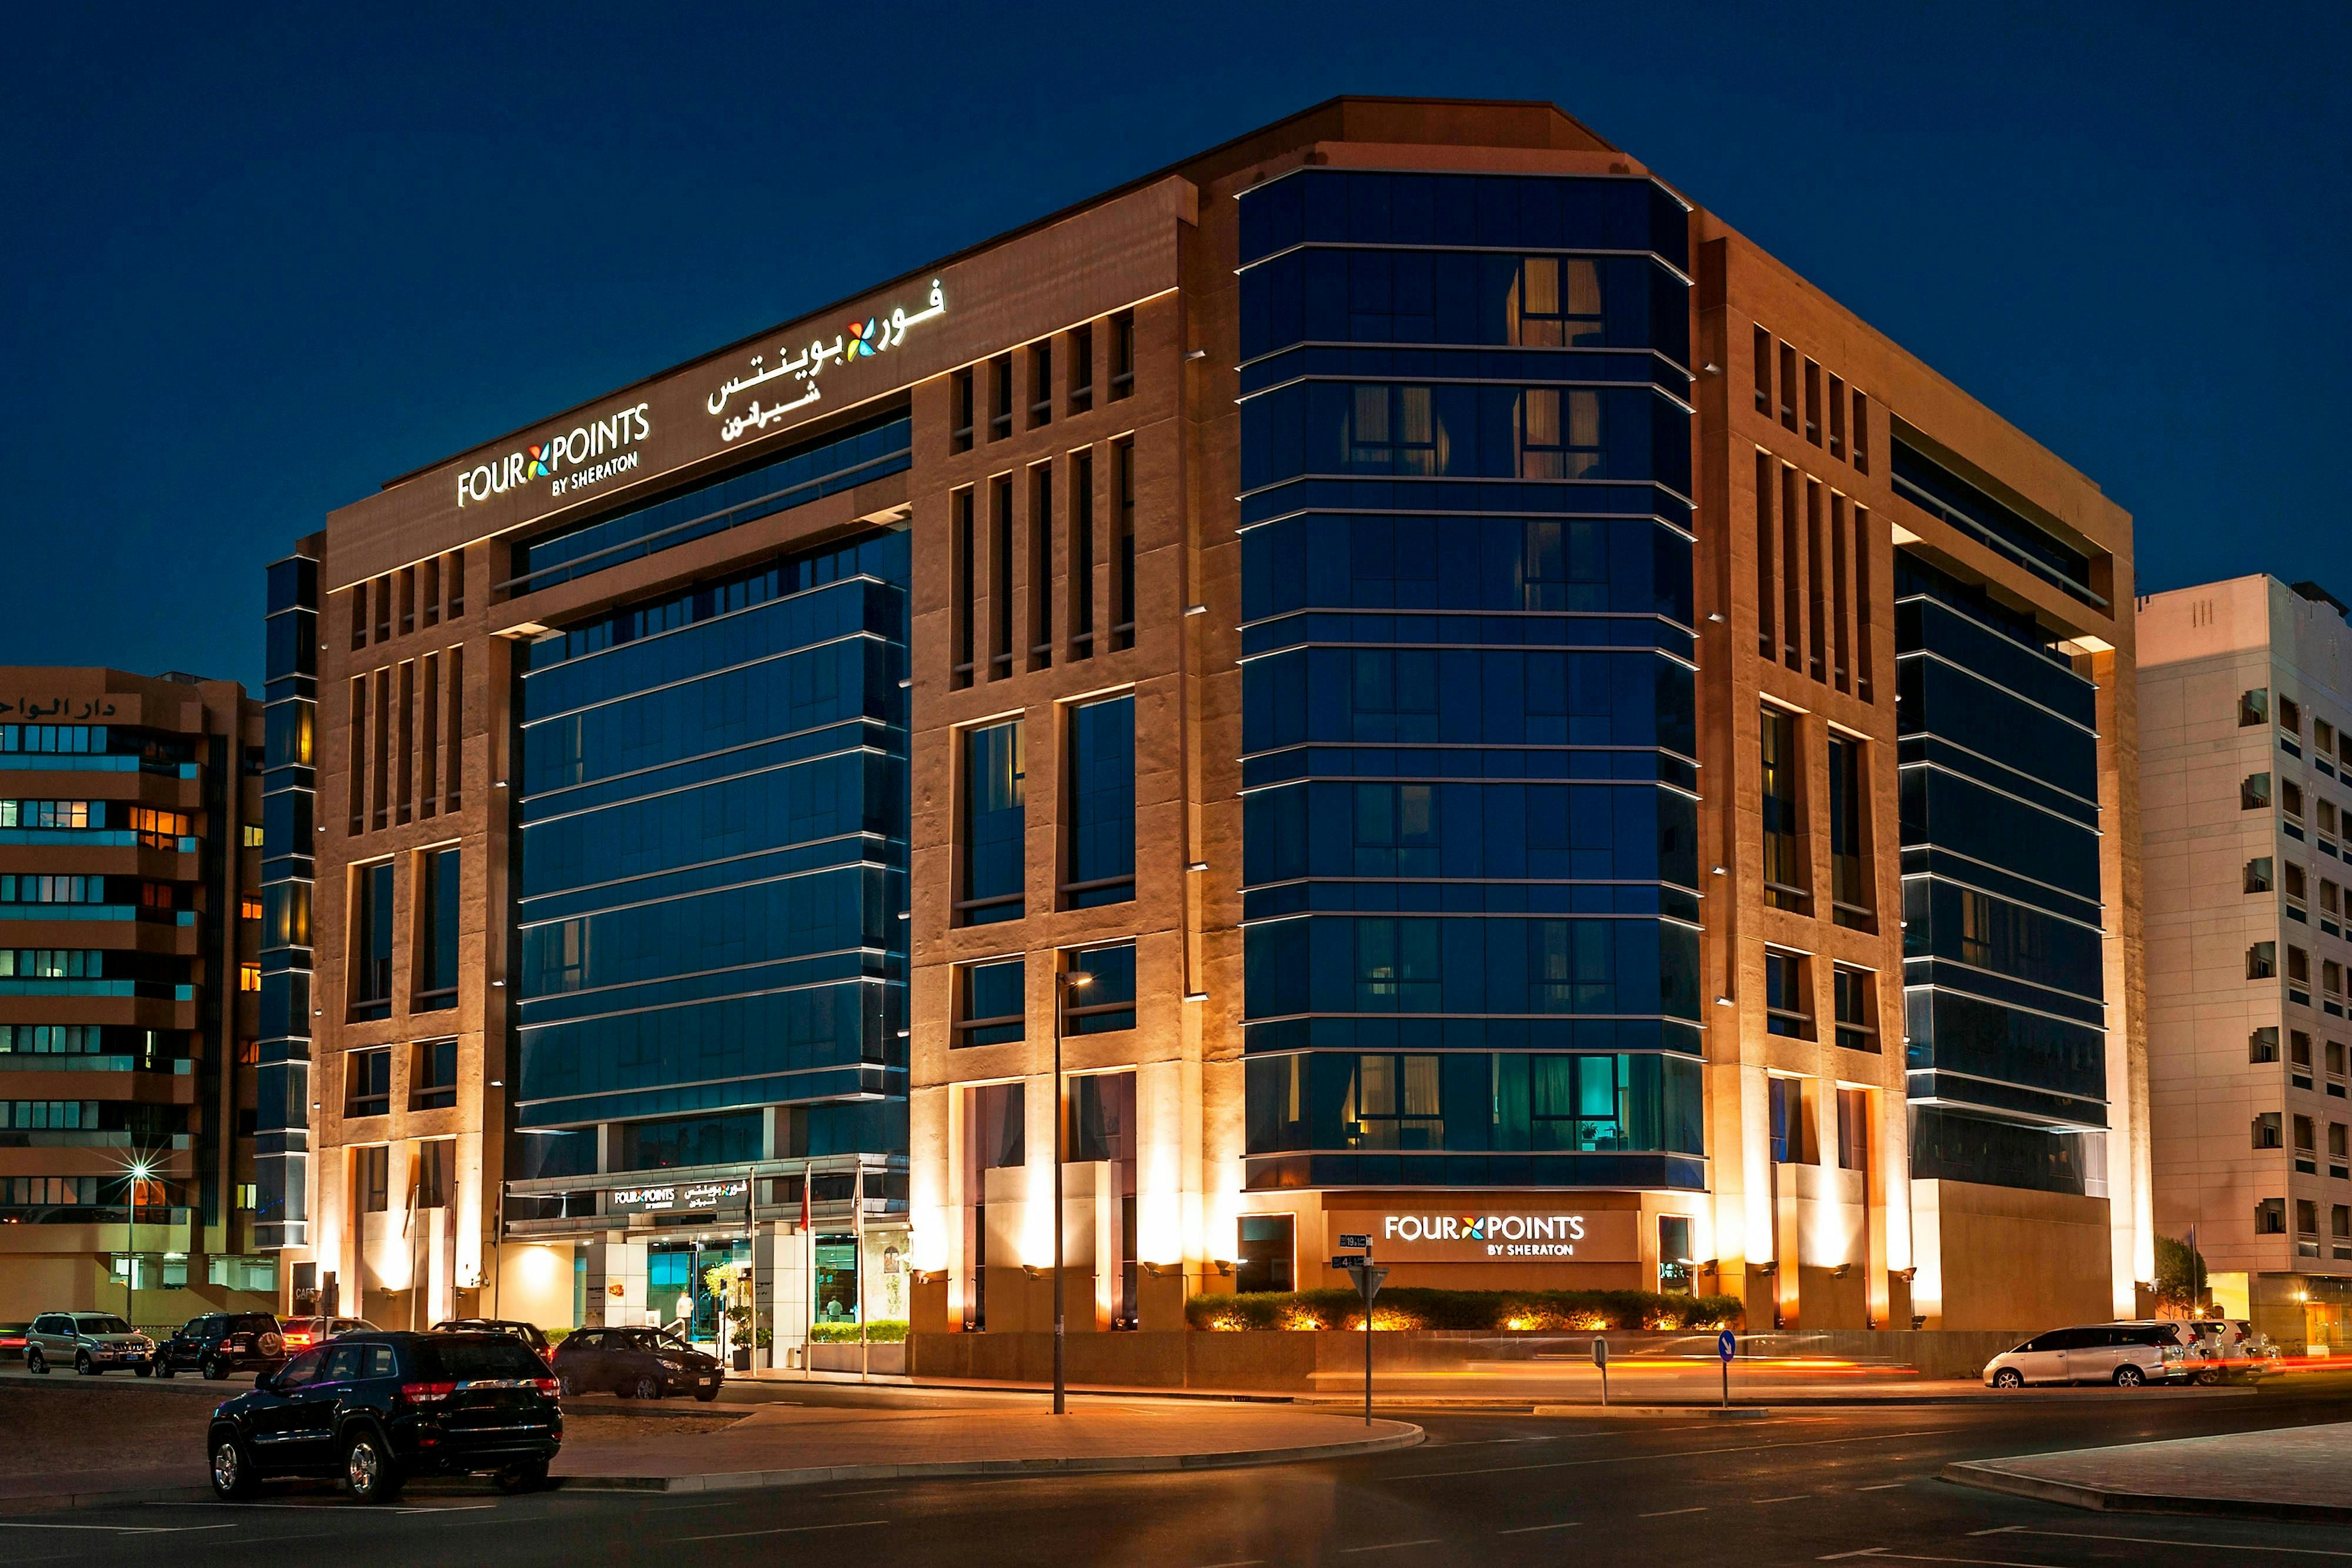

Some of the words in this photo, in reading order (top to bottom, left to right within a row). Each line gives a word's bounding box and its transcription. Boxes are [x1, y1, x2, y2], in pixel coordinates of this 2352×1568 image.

[877, 279, 946, 352] فور
[707, 335, 844, 415] بوينتس
[457, 452, 528, 508] FOUR
[552, 402, 649, 472] POINTS
[552, 476, 569, 497] BY
[571, 451, 639, 490] SHERATON
[74, 698, 116, 720] دار
[614, 1192, 639, 1204] FOUR
[644, 1188, 676, 1202] POINTS
[1385, 1216, 1461, 1241] FOUR
[1488, 1216, 1585, 1241] POINTS
[1487, 1244, 1504, 1256] BY
[1507, 1244, 1573, 1256] SHERATON
